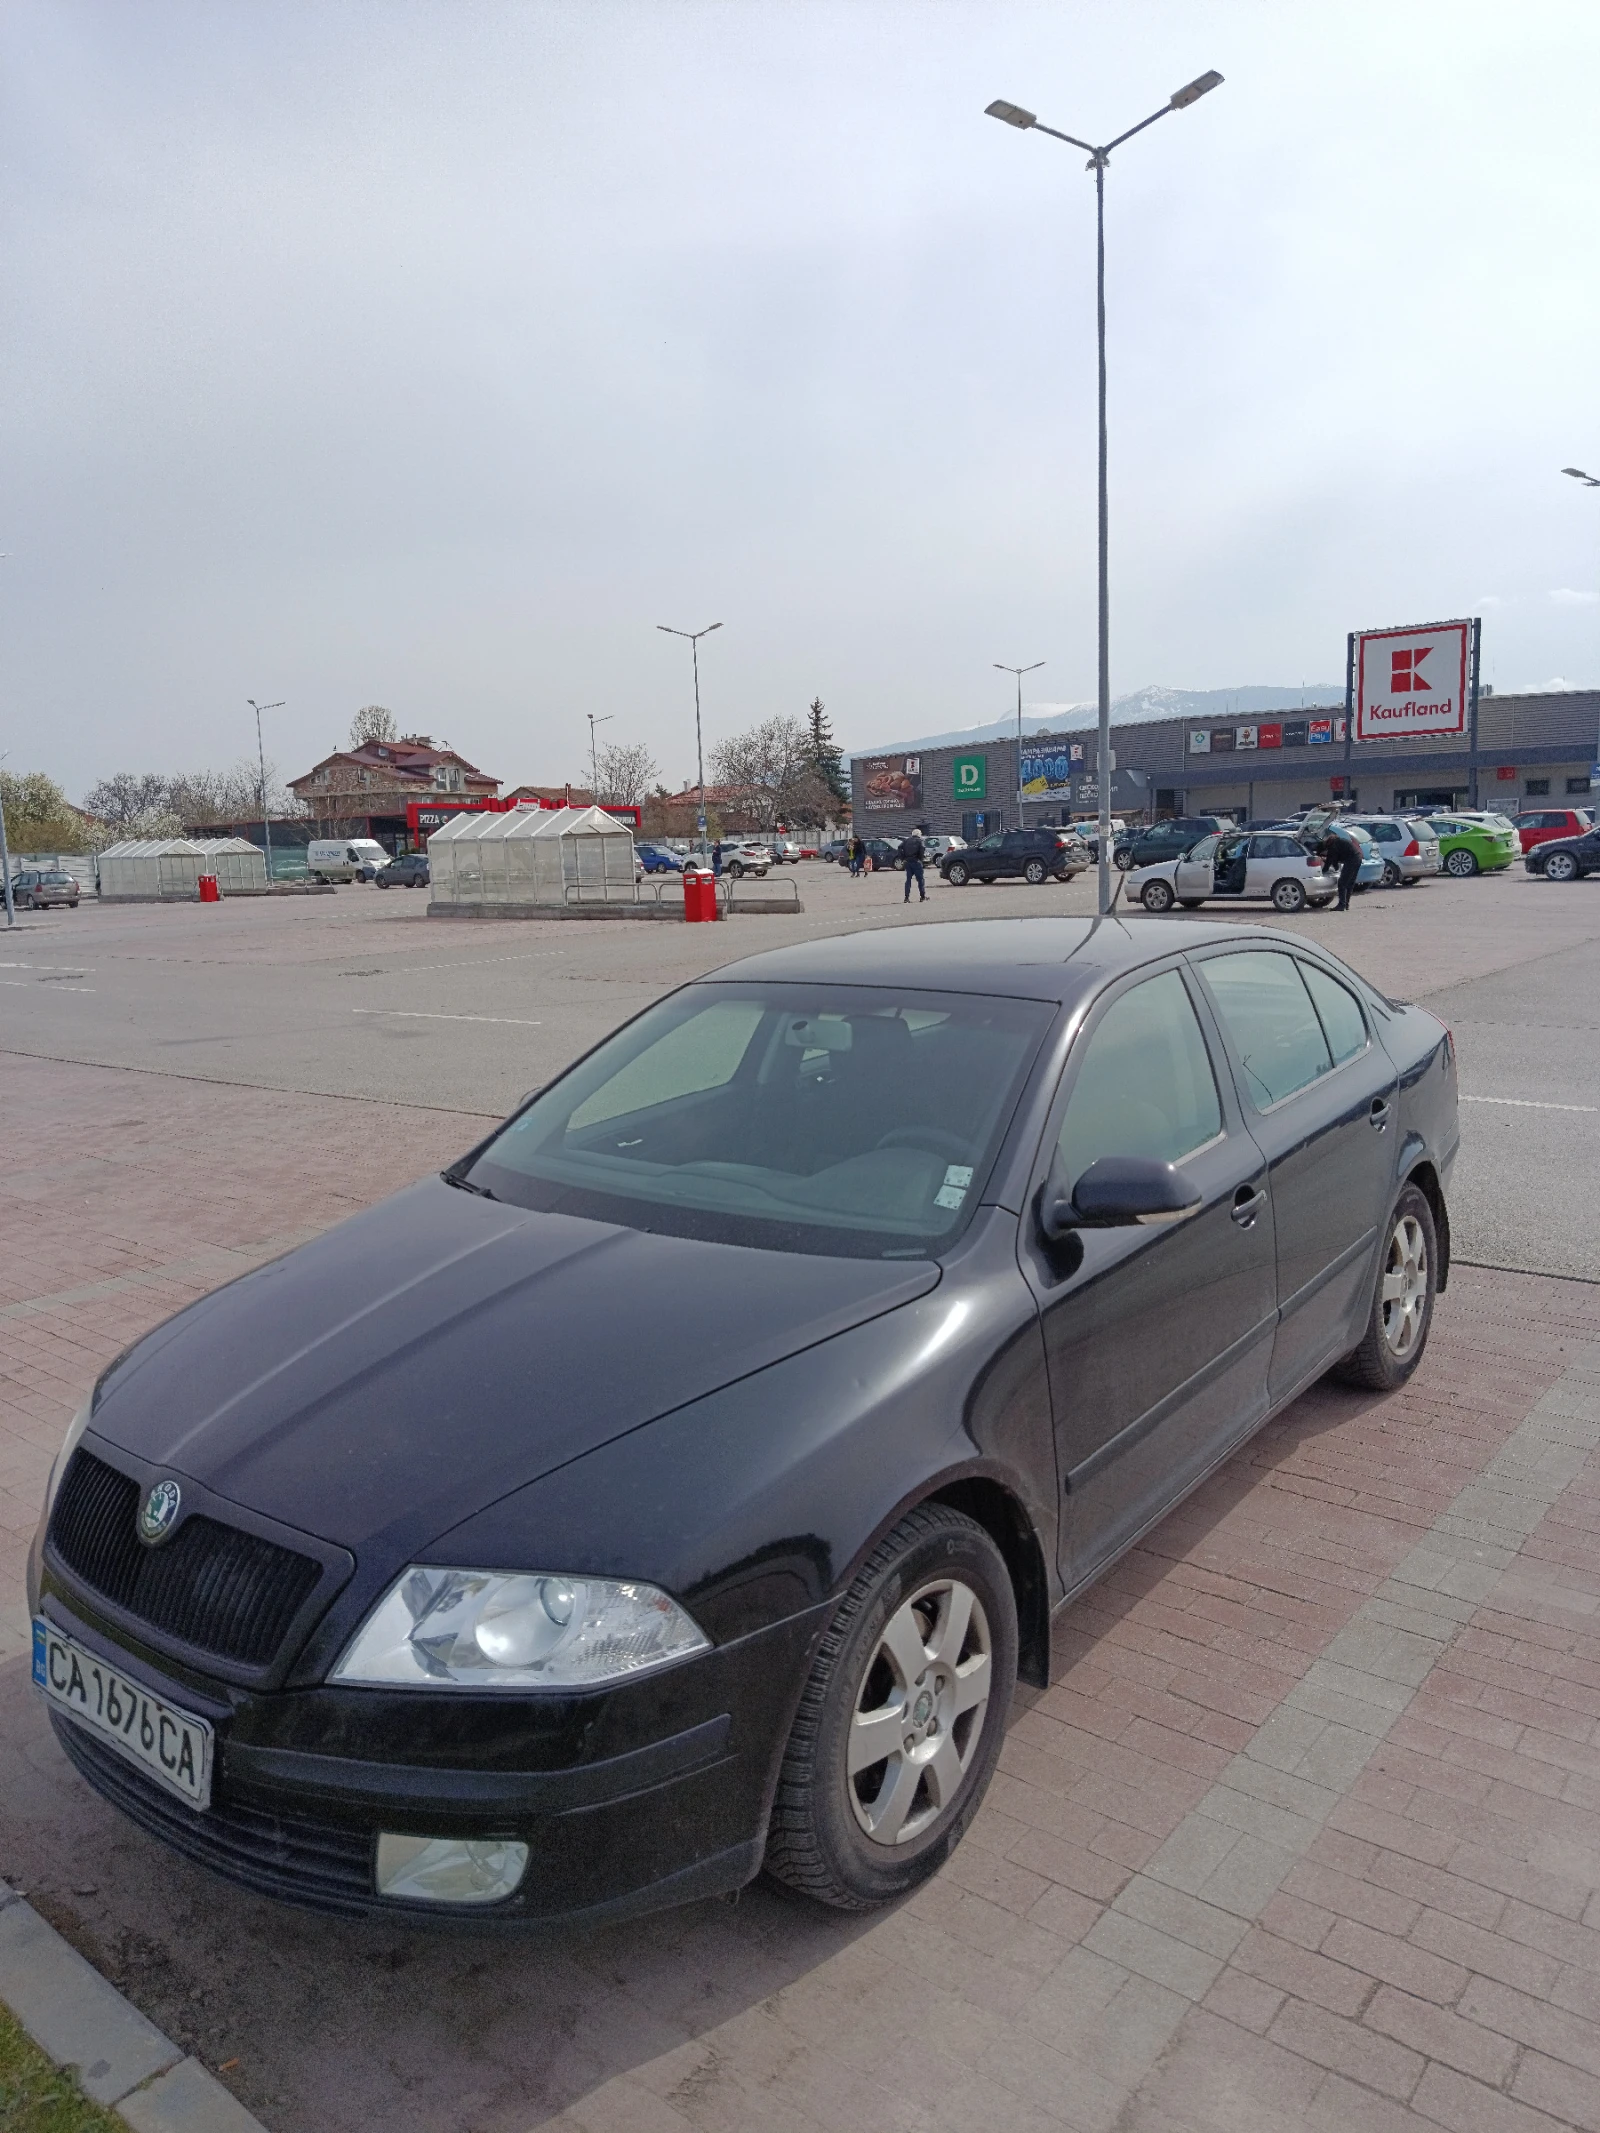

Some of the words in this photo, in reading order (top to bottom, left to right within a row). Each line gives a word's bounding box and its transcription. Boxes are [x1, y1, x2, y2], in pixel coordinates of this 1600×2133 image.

[1370, 698, 1451, 720] Kaufland
[1310, 724, 1330, 733] Easy
[1310, 733, 1325, 742] Pay
[960, 764, 979, 786] D
[1021, 755, 1069, 782] 4000
[419, 814, 440, 824] PIZZA
[35, 1659, 46, 1676] BG
[50, 1641, 195, 1787] CA1676CA
